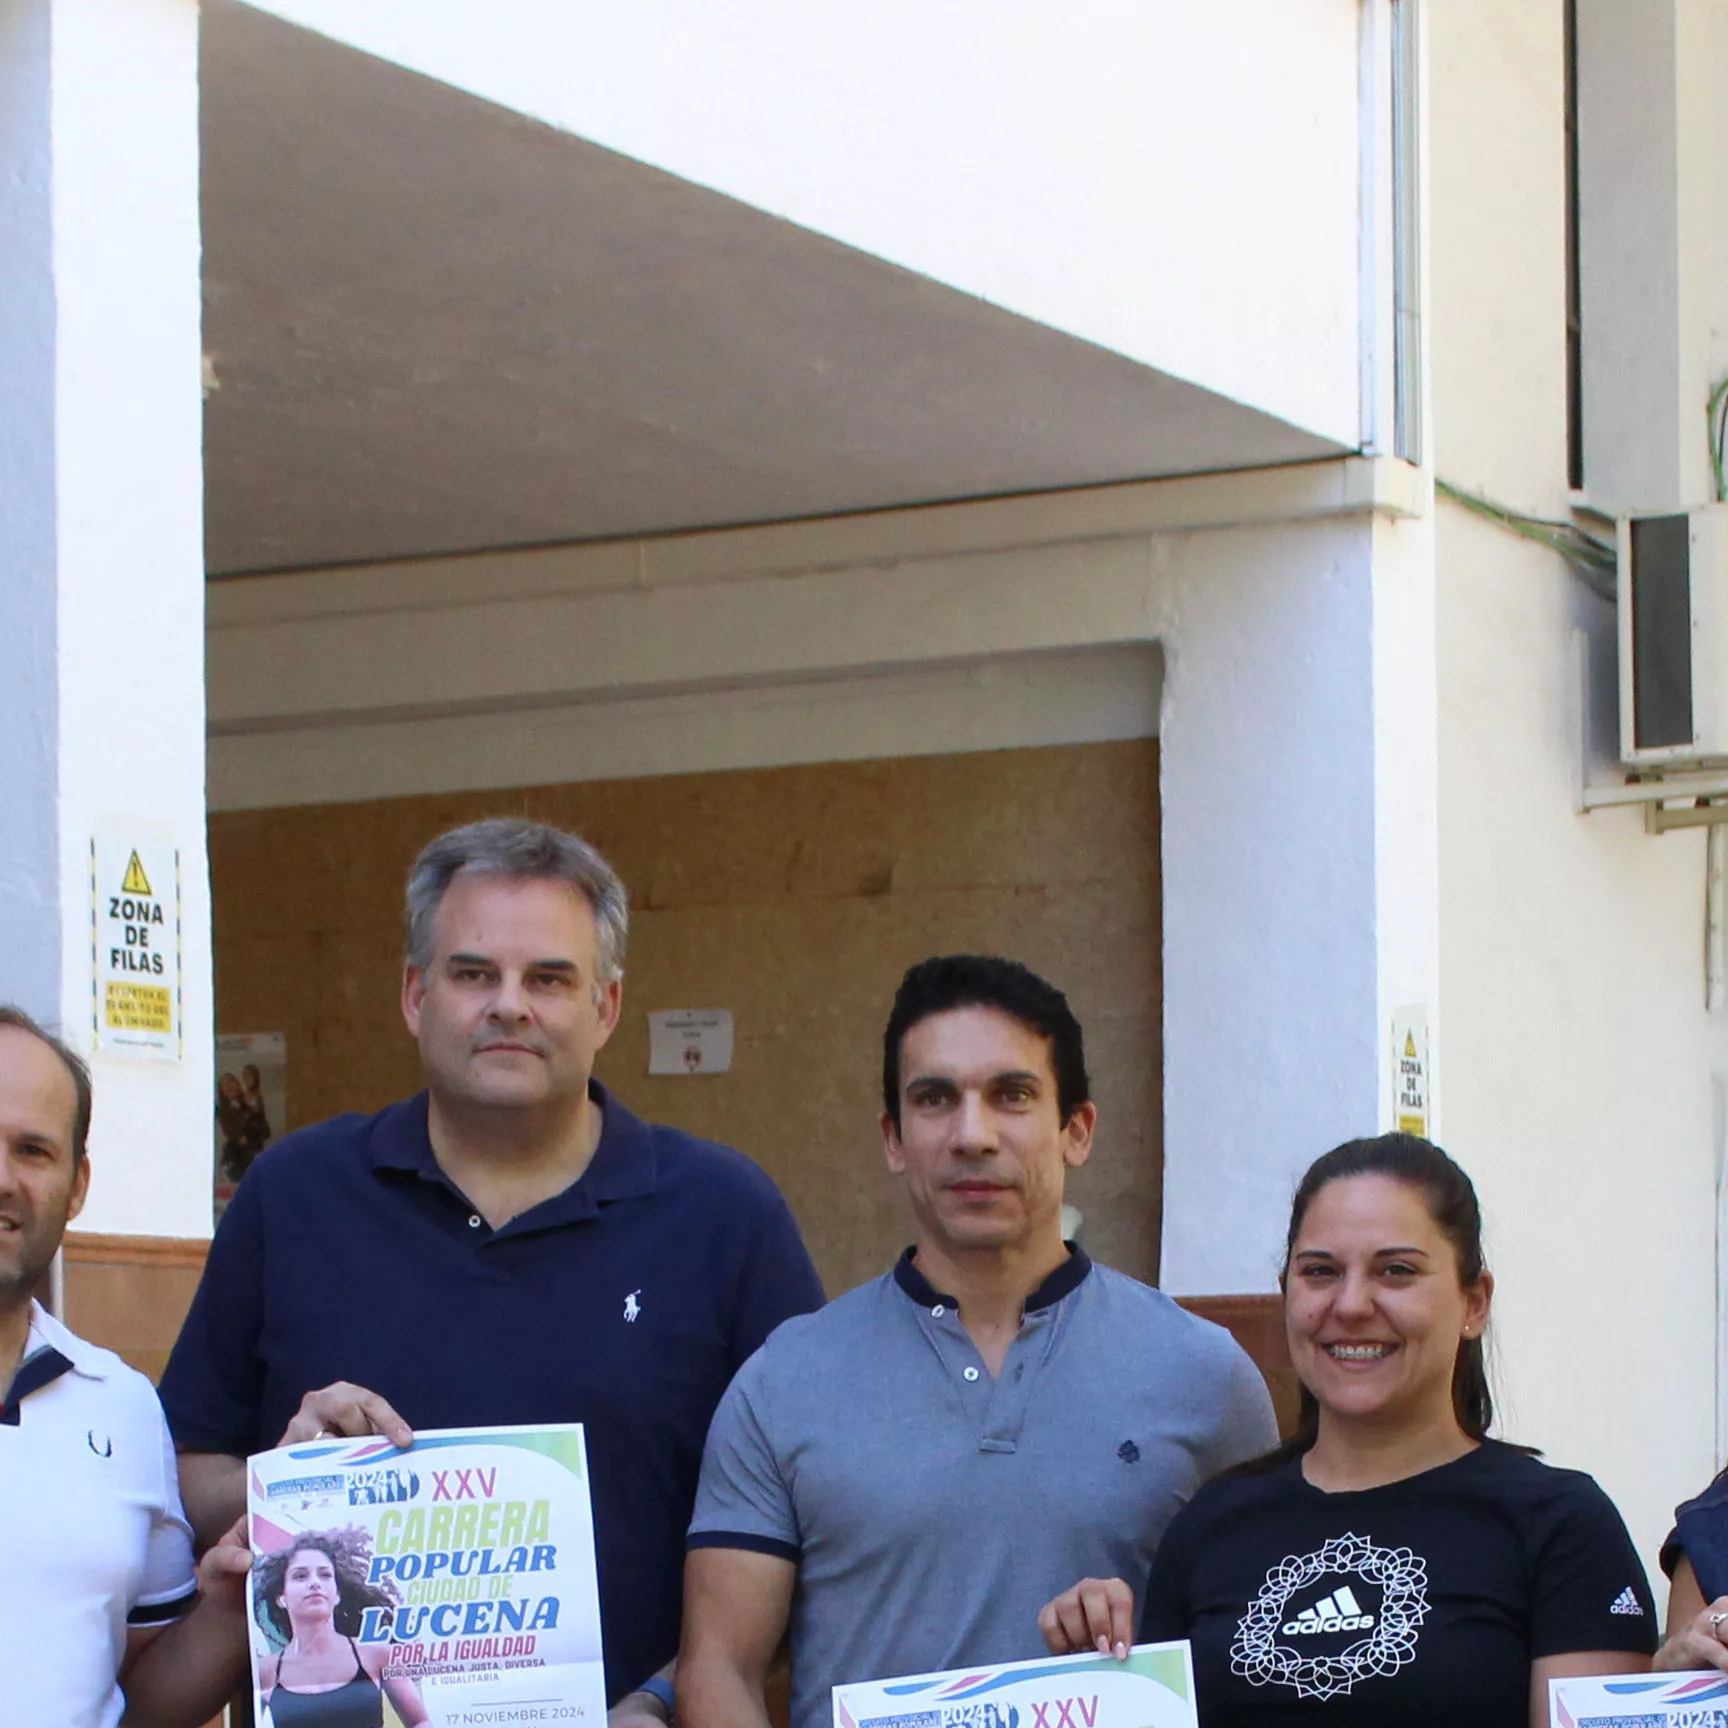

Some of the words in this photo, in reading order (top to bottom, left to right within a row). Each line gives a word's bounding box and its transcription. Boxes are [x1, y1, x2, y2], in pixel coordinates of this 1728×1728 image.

[109, 897, 164, 925] ZONA
[125, 924, 149, 947] DE
[110, 948, 164, 975] FILAS
[1400, 1059, 1422, 1076] ZONA
[1406, 1076, 1416, 1092] DE
[1400, 1092, 1422, 1109] FILAS
[347, 1471, 387, 1489] 2024
[431, 1467, 497, 1501] XXV
[376, 1499, 551, 1555] CARRERA
[368, 1544, 558, 1583] POPULAR
[408, 1576, 481, 1605] CIUDAD
[488, 1575, 513, 1599] DE
[359, 1596, 561, 1643] LUCENA
[1282, 1615, 1375, 1636] adidas
[390, 1643, 424, 1665] POR
[429, 1641, 449, 1662] LA
[454, 1635, 537, 1660] IGUALDAD
[383, 1667, 402, 1679] POR
[405, 1666, 423, 1677] UNA
[427, 1665, 465, 1676] LUCENA
[505, 1658, 546, 1669] DIVERSA
[431, 1675, 438, 1686] E
[440, 1672, 500, 1685] IGUALITARIA
[445, 1714, 459, 1726] 17
[463, 1708, 547, 1724] NOVIEMBRE
[551, 1706, 585, 1719] 2024
[943, 1704, 985, 1724] 2024
